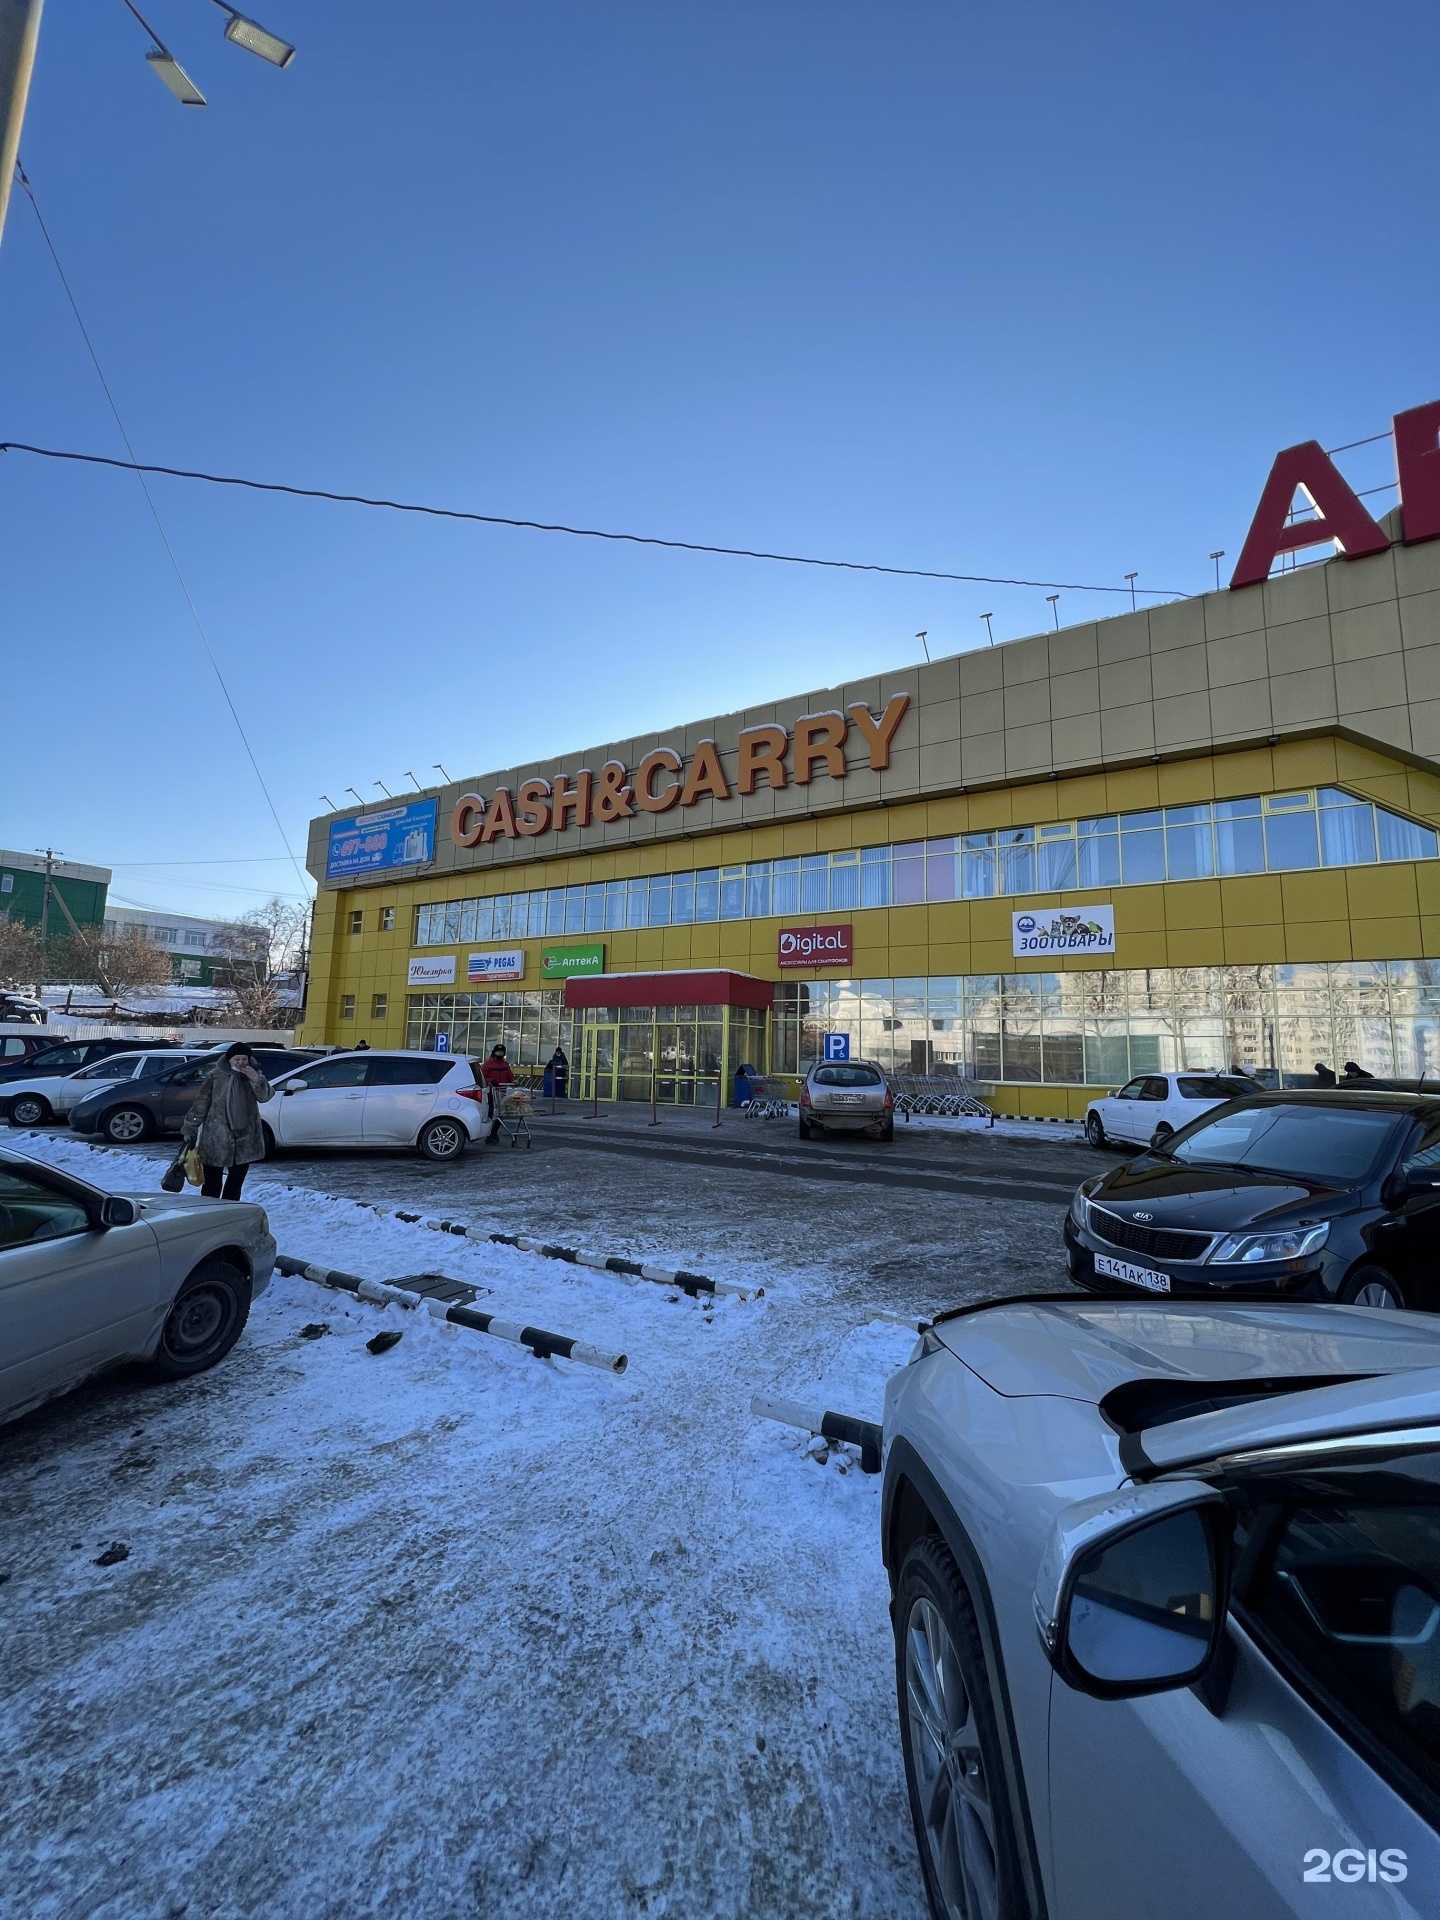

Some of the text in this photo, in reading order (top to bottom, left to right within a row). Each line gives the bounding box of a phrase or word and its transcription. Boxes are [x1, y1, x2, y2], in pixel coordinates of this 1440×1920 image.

[453, 692, 911, 848] CASH&CARRY
[780, 930, 848, 955] Digital
[1020, 933, 1113, 950] ЗООТОВАРЫ
[494, 957, 515, 968] PEGAS
[829, 1035, 846, 1058] P
[1135, 1212, 1149, 1220] KIA
